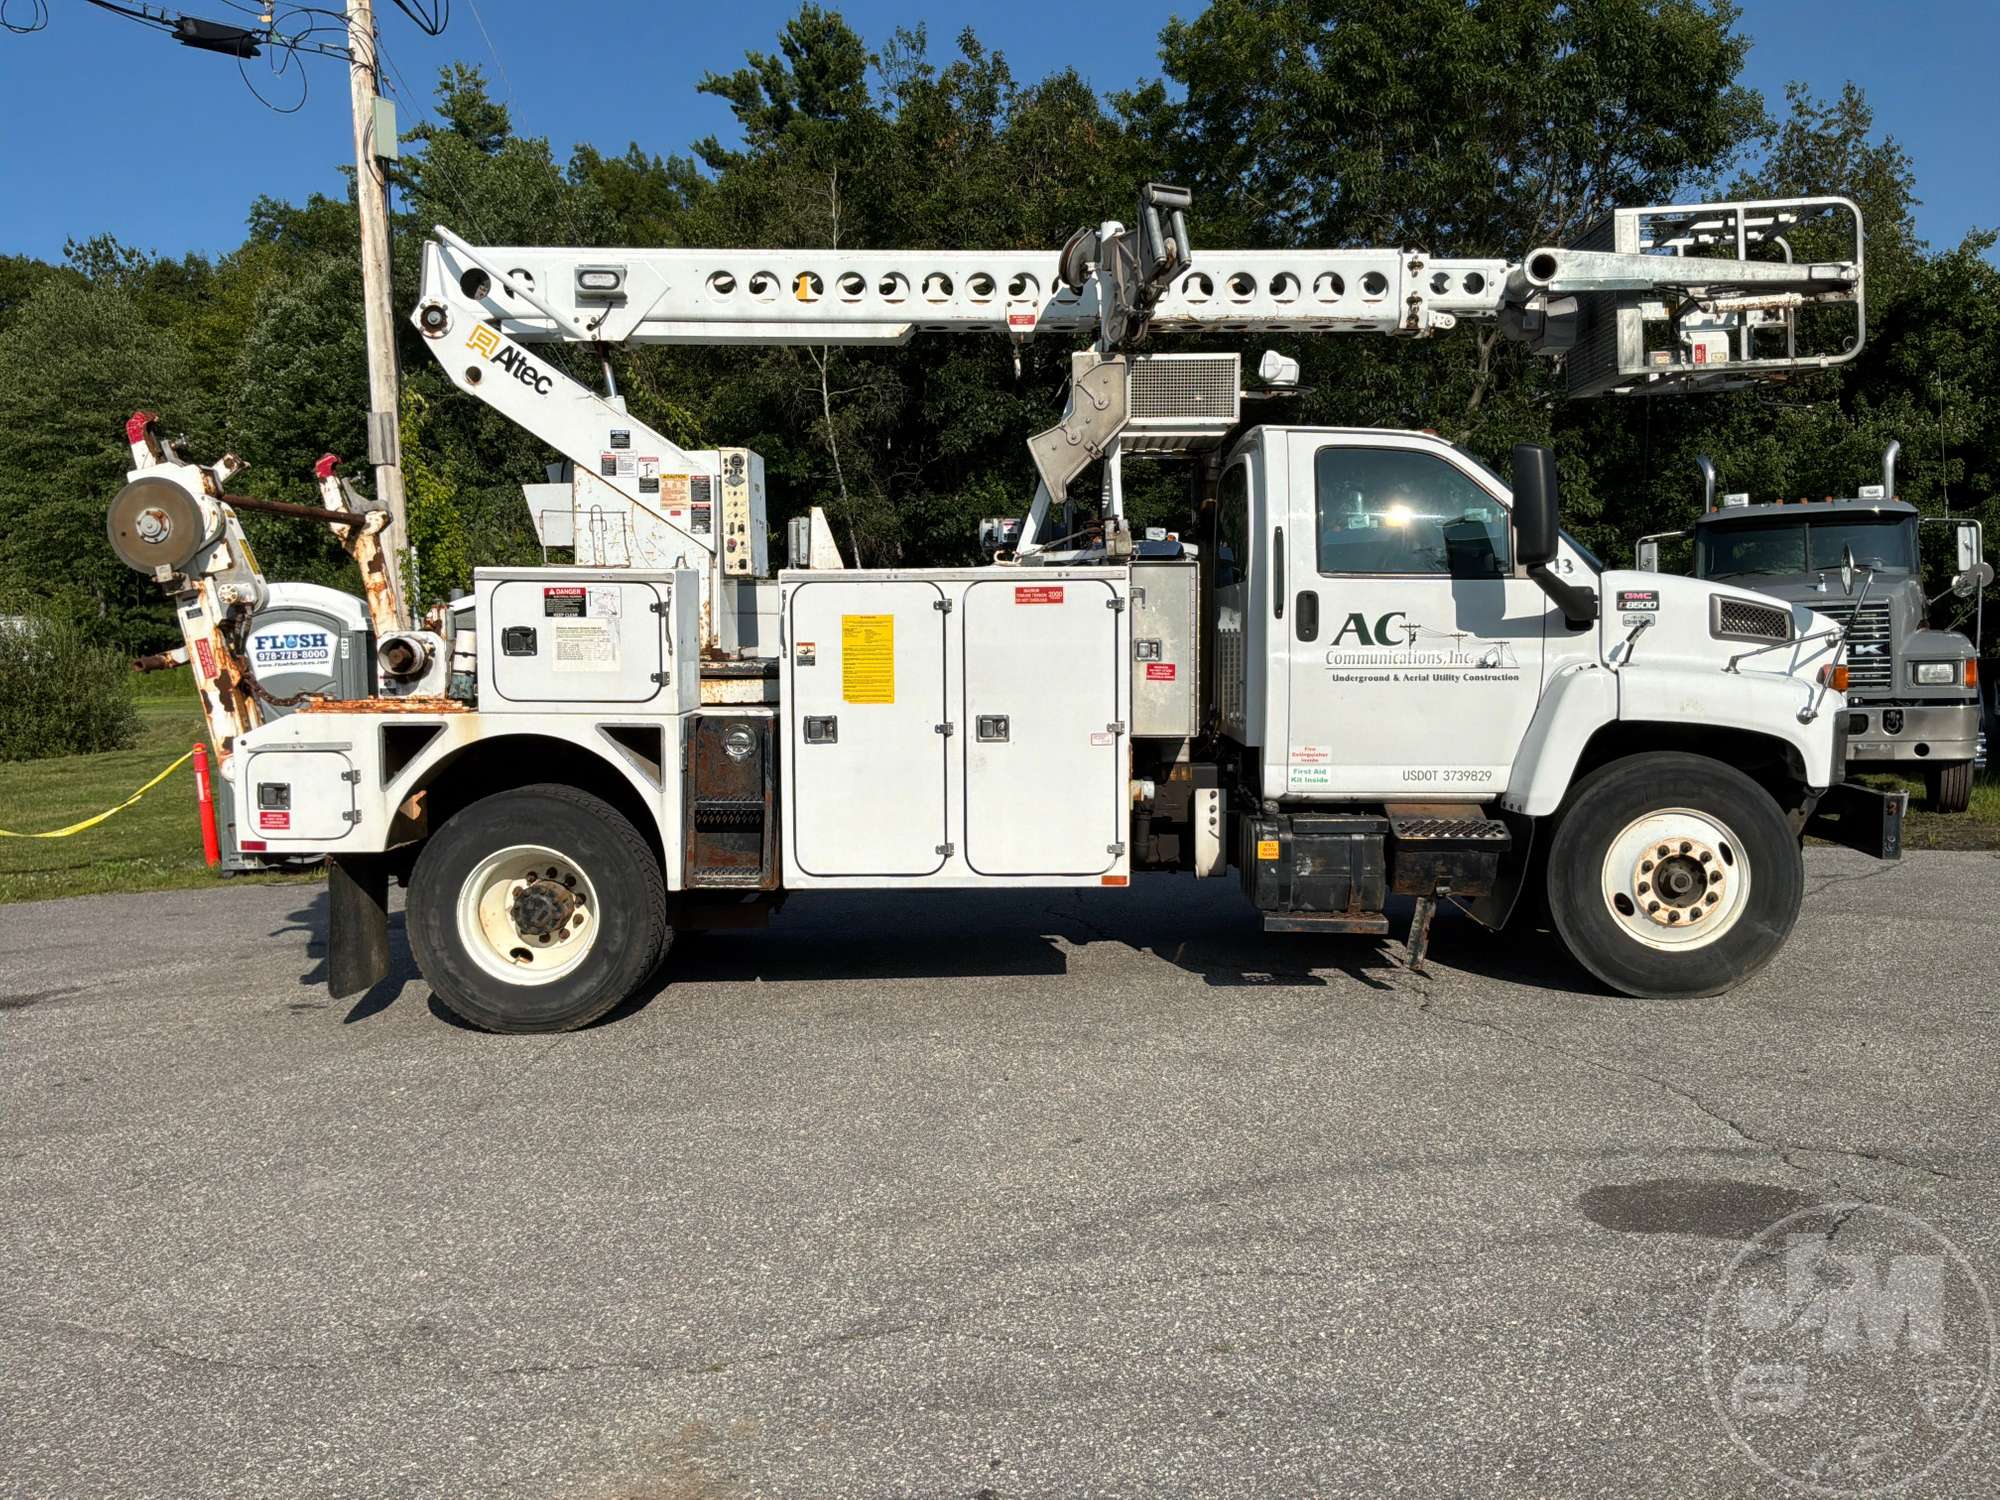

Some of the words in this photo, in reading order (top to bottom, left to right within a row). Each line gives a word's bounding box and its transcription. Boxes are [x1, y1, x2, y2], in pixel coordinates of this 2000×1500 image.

[490, 345, 552, 395] Altec
[1330, 611, 1406, 647] AC
[254, 633, 328, 650] FLUSH
[258, 649, 326, 660] 978-778-8000
[1332, 673, 1390, 683] Underground
[1392, 673, 1400, 681] &
[1403, 673, 1429, 681] Aerial
[1432, 673, 1460, 683] Utility
[1463, 673, 1519, 681] Construction
[1402, 769, 1438, 781] USDOT
[1442, 769, 1493, 782] 3739829
